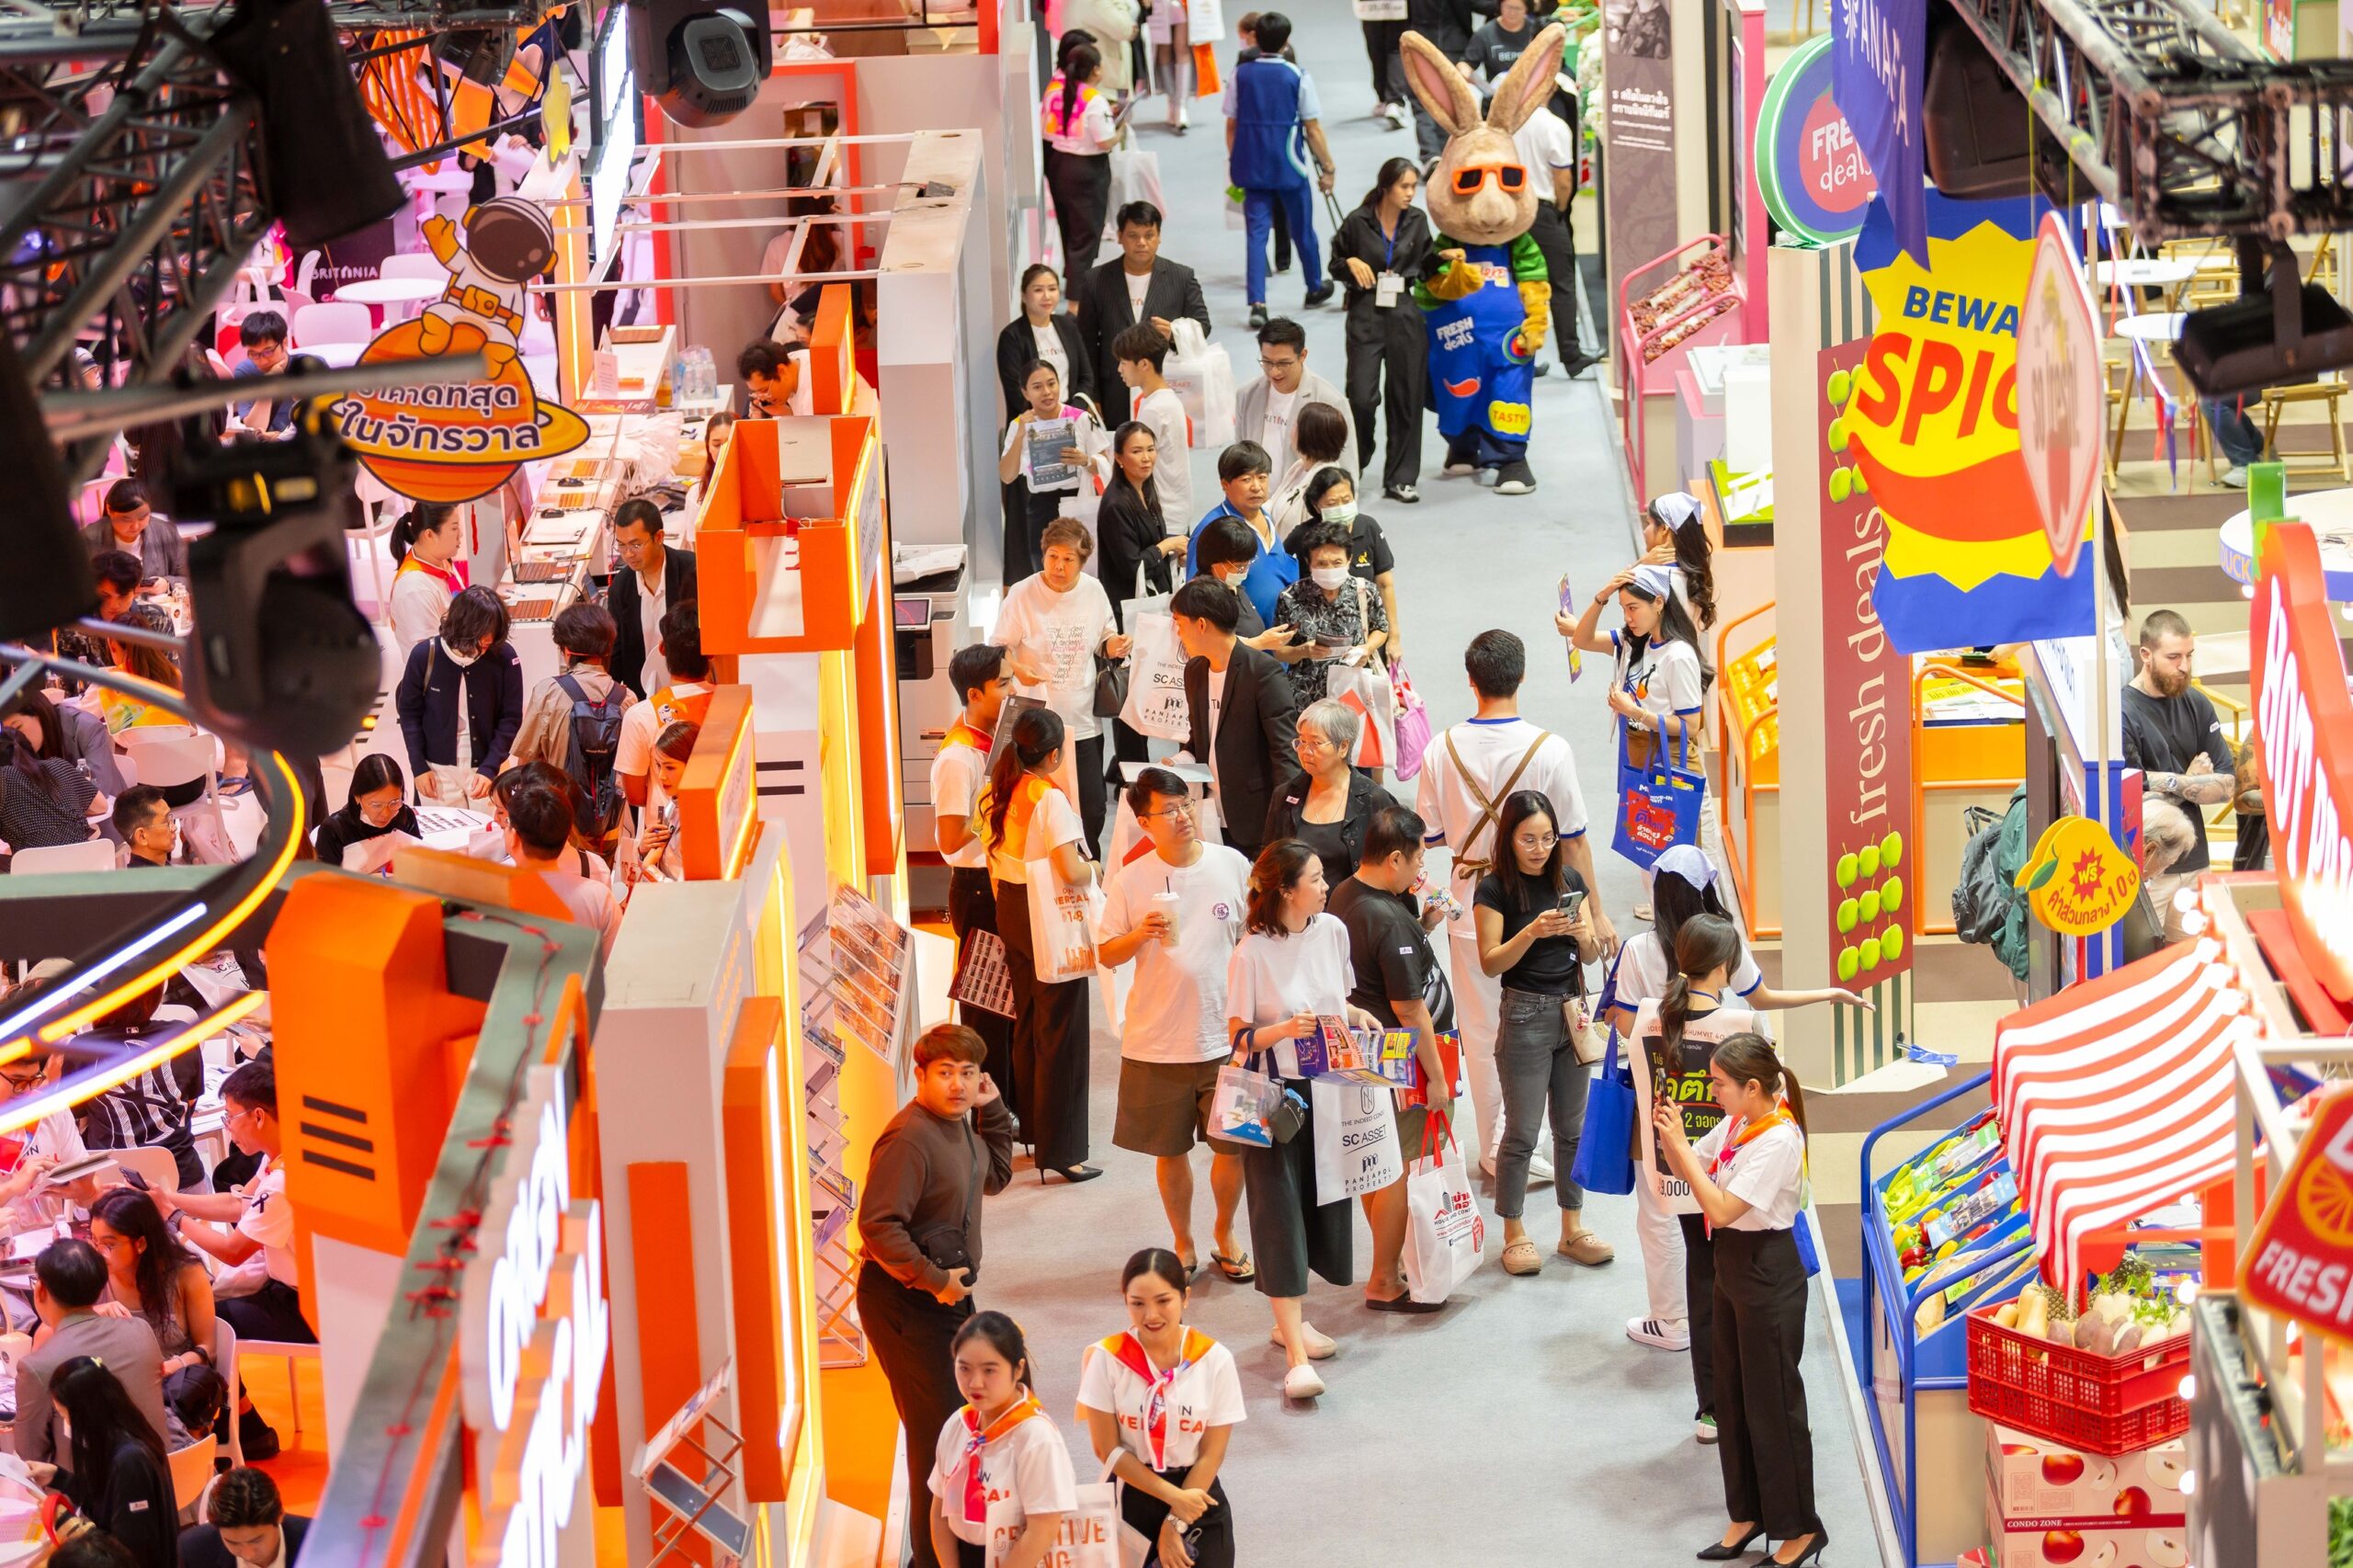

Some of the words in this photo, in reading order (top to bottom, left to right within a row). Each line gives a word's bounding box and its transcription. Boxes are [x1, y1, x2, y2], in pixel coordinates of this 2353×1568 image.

[1813, 117, 1855, 162] FRE
[1903, 284, 2019, 339] BEWA
[1436, 315, 1474, 341] FRESH
[1444, 331, 1474, 351] deals
[1856, 331, 2019, 447] SPIC
[341, 401, 540, 451] ในจักรวาล
[1846, 506, 1885, 663] deals
[1143, 715, 1189, 728] PROPERT
[1145, 709, 1189, 722] PANJAPO
[1848, 670, 1887, 827] fresh
[2078, 861, 2097, 885] ฟรี
[2047, 886, 2111, 926] ค่าส่วนกลาง
[2108, 875, 2128, 906] 10
[1682, 1029, 1714, 1038] KHUMVIT
[1353, 1116, 1373, 1125] INDEED
[1685, 1112, 1693, 1128] 2
[1343, 1132, 1359, 1147] SC
[1360, 1124, 1387, 1143] ASSET
[1345, 1168, 1392, 1186] PANJAPOL
[1345, 1175, 1392, 1194] PROPERTY
[2007, 1520, 2038, 1529] CONDO
[2040, 1519, 2062, 1528] ZONE
